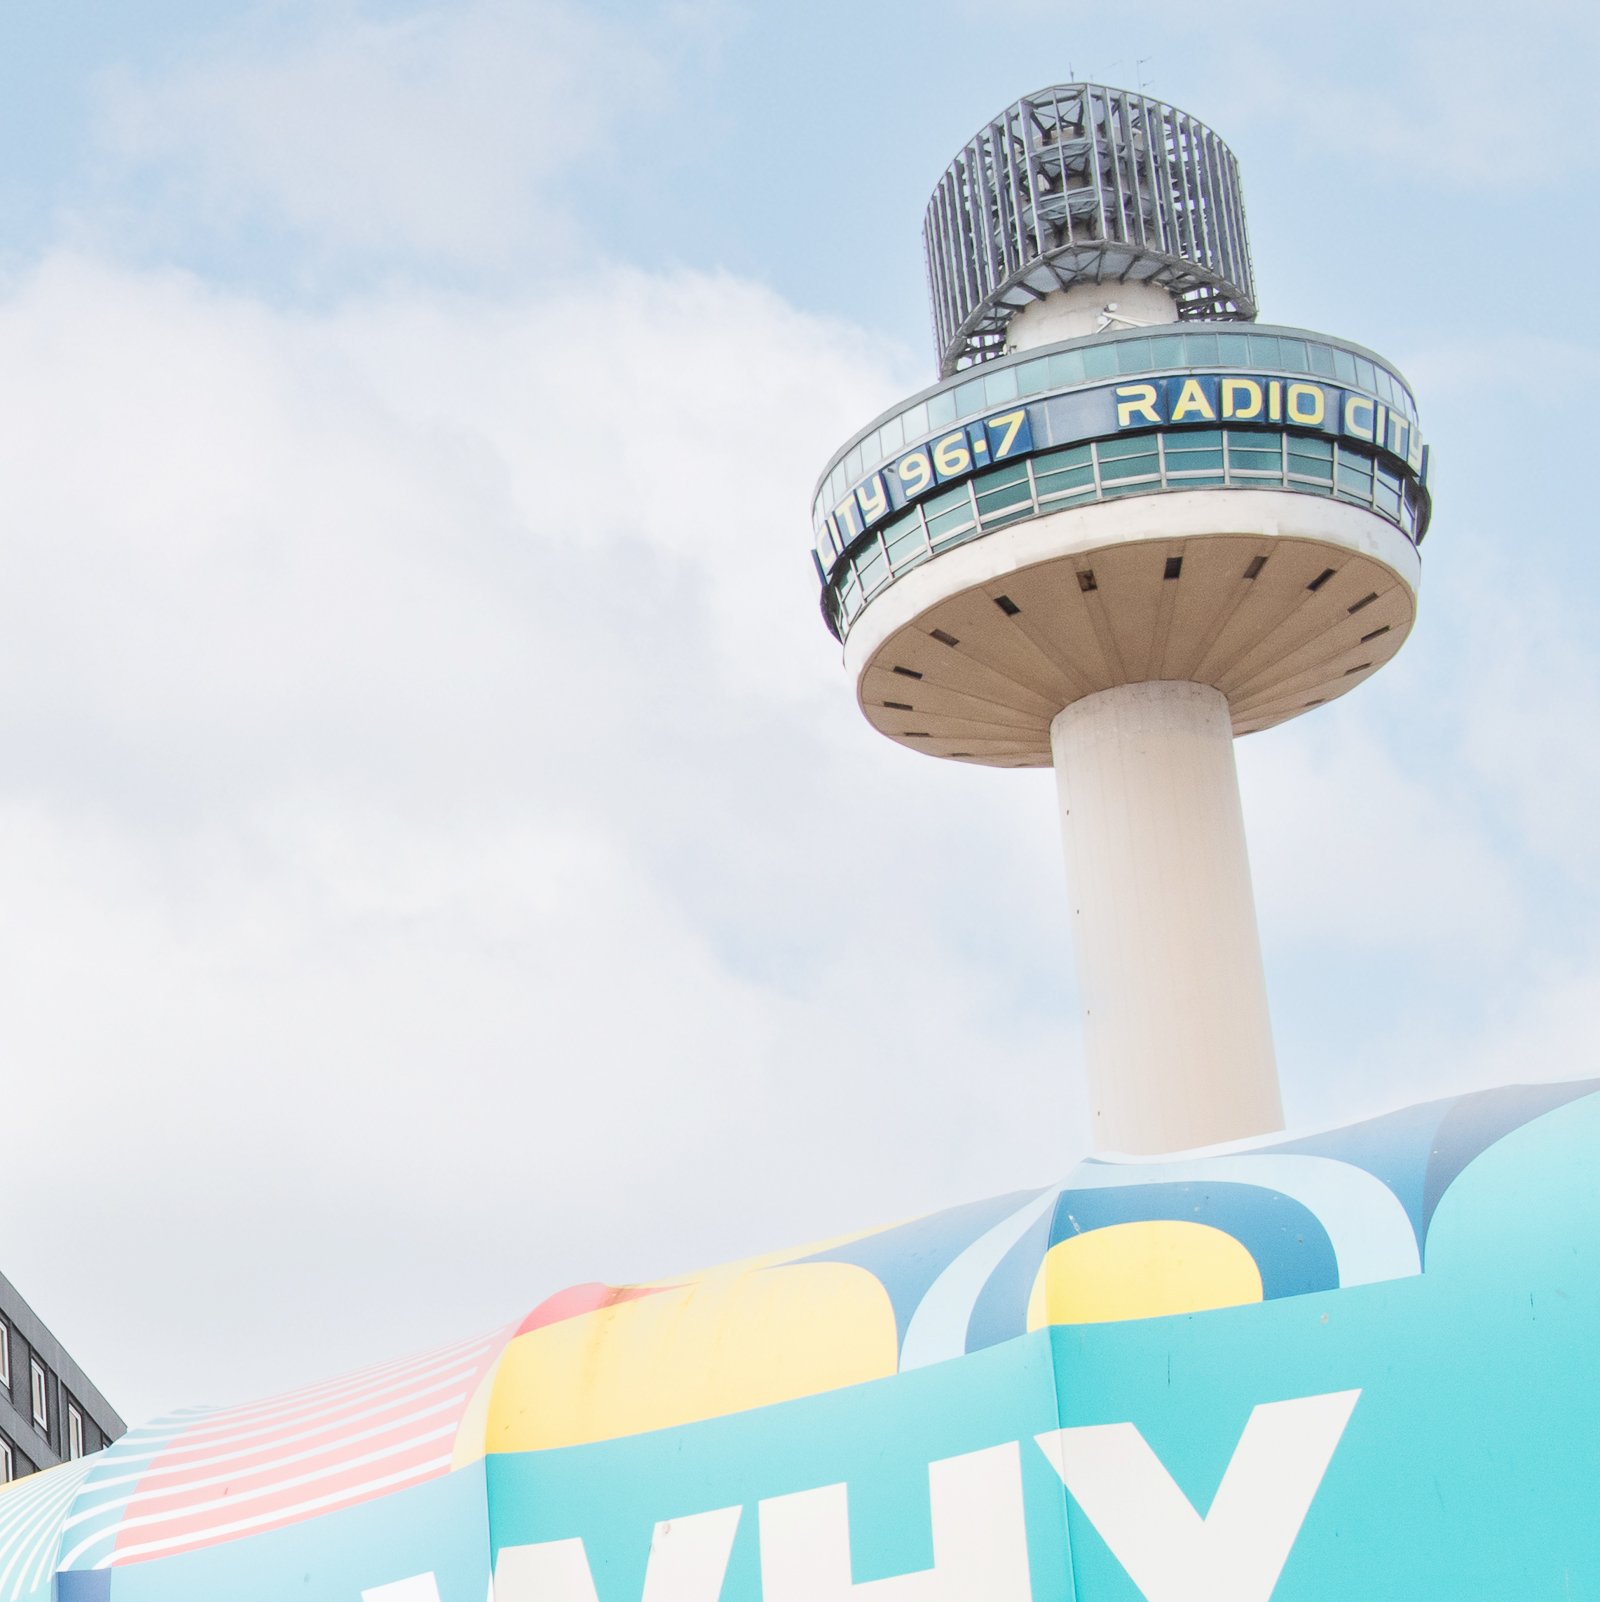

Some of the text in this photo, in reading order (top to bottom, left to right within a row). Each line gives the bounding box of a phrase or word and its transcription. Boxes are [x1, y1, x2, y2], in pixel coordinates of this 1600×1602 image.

[1115, 379, 1423, 475] RADIO CITY
[815, 473, 888, 570] CITY
